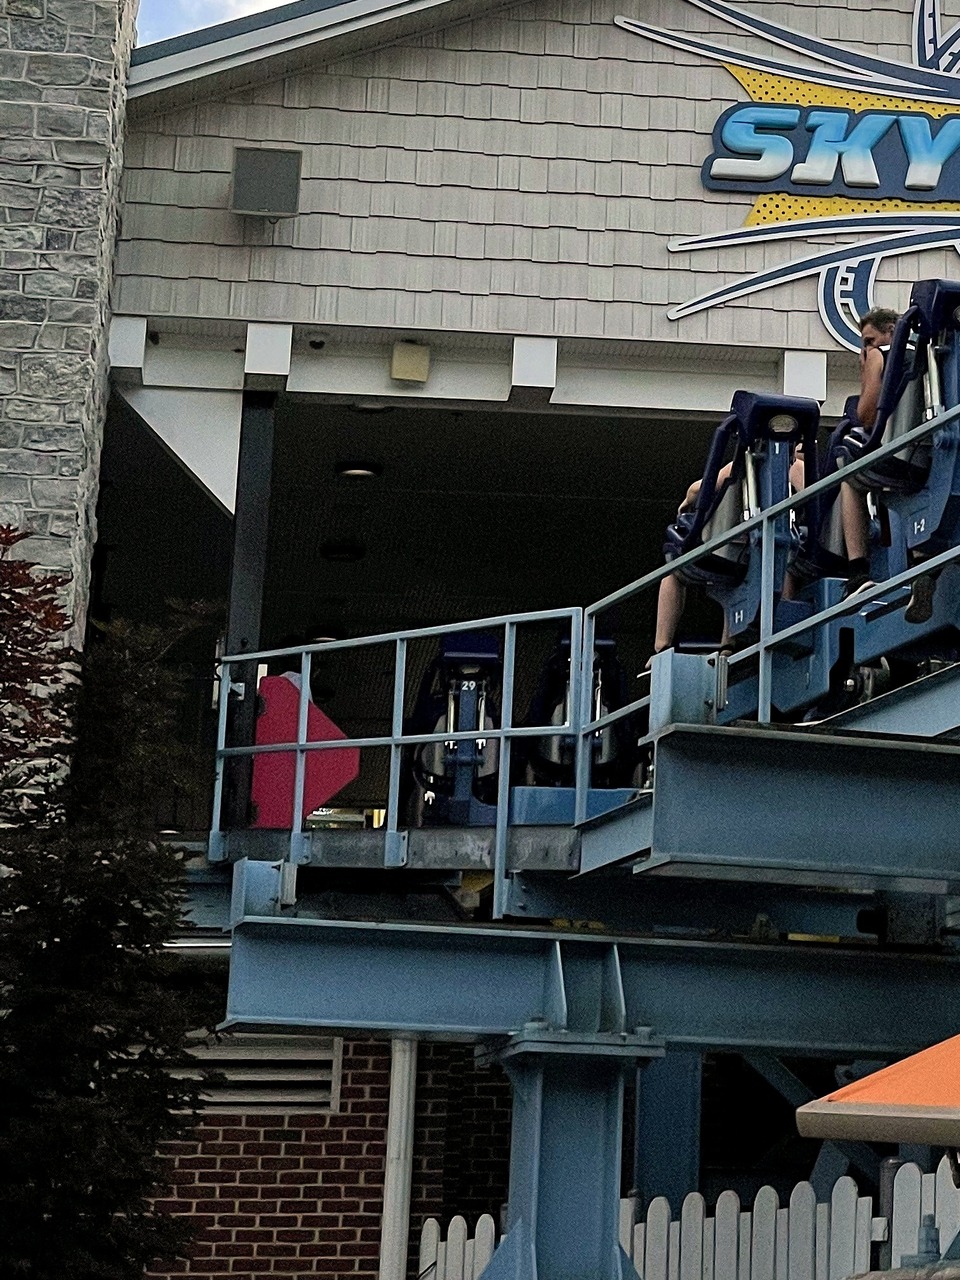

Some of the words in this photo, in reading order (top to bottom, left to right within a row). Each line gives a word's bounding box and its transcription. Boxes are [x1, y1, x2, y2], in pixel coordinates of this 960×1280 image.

[774, 442, 780, 456] 1
[914, 518, 926, 535] 1-2
[461, 679, 476, 692] 29
